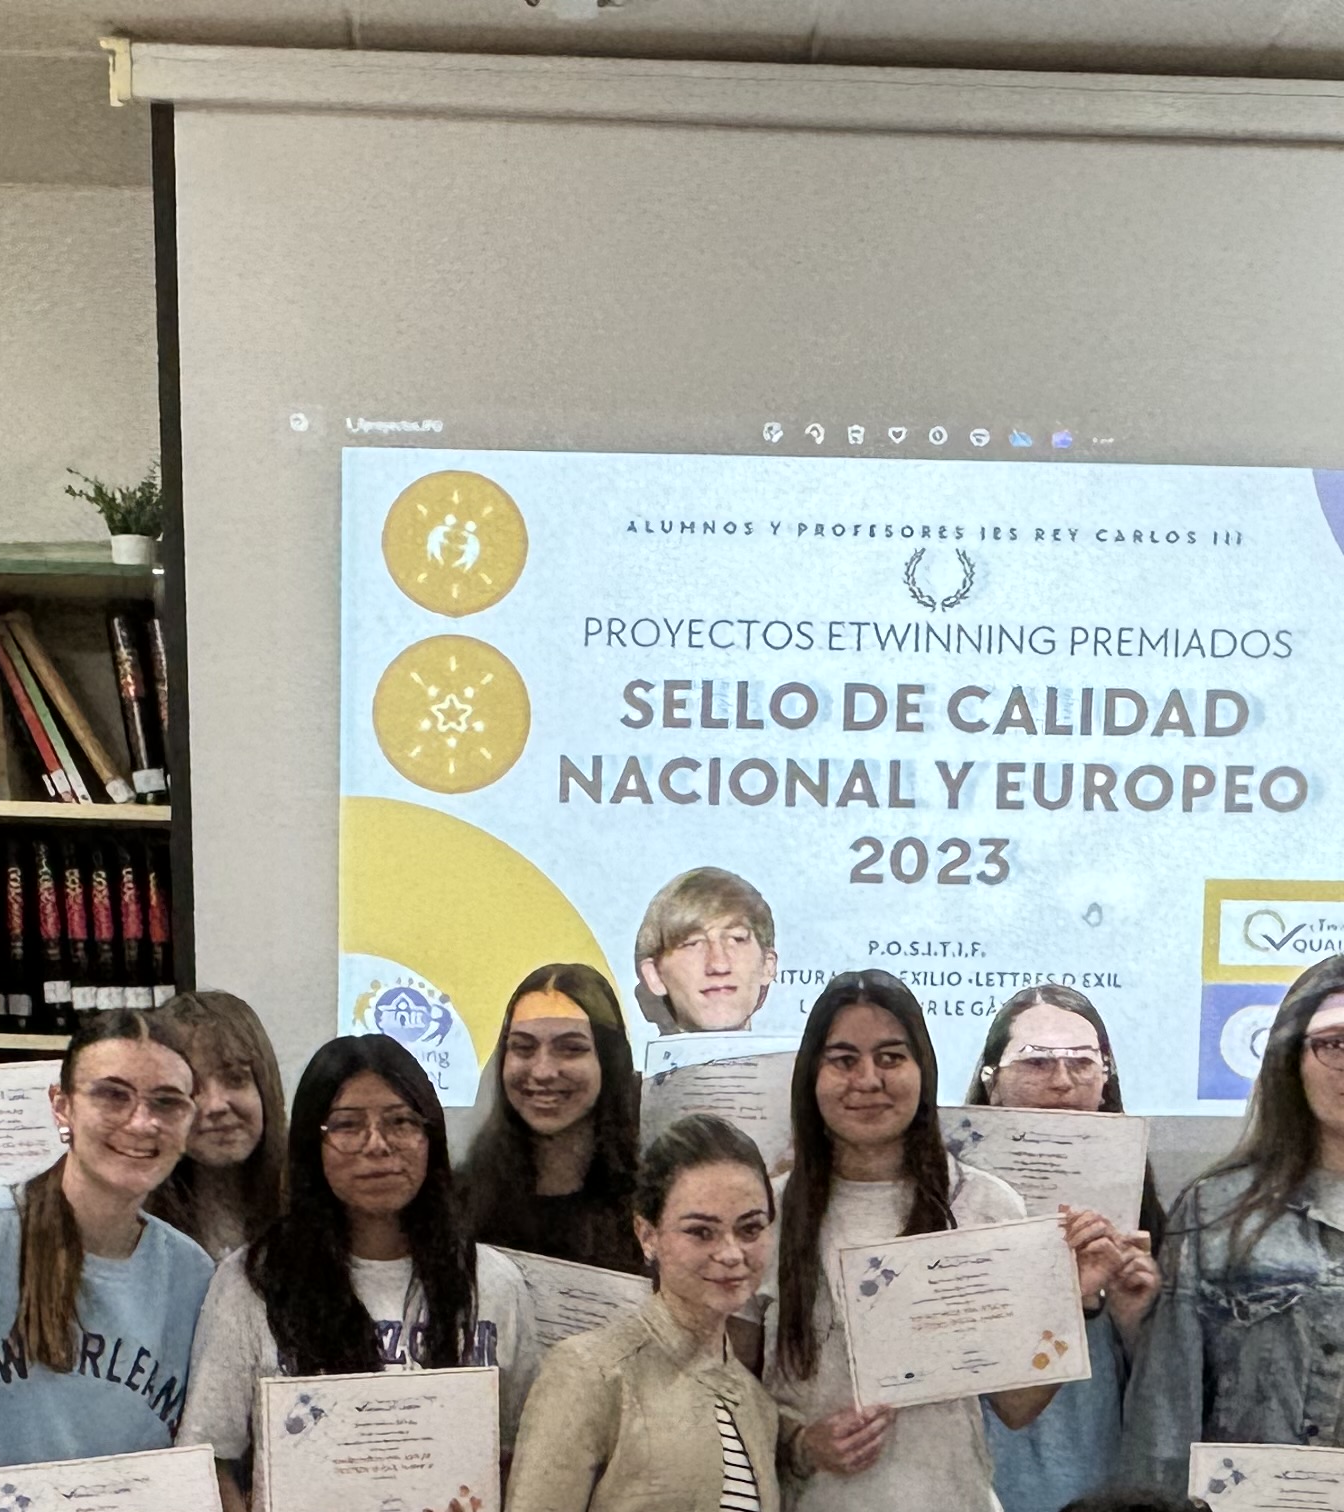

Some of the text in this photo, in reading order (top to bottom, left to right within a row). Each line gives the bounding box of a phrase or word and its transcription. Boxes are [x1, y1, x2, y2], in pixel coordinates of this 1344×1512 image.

[626, 519, 754, 536] ALUMNOS
[770, 520, 782, 536] Y
[797, 522, 965, 540] PROFESORES
[1035, 528, 1079, 542] REY
[1096, 528, 1197, 544] CARLOS
[1212, 531, 1243, 546] III
[583, 617, 1293, 659] PROYECTOS ETWINNING PREMIADOS
[619, 679, 1251, 738] SELLO DE CALIDAD
[558, 754, 1310, 814] NACIONAL Y EUROPEO
[849, 835, 1012, 887] 2023
